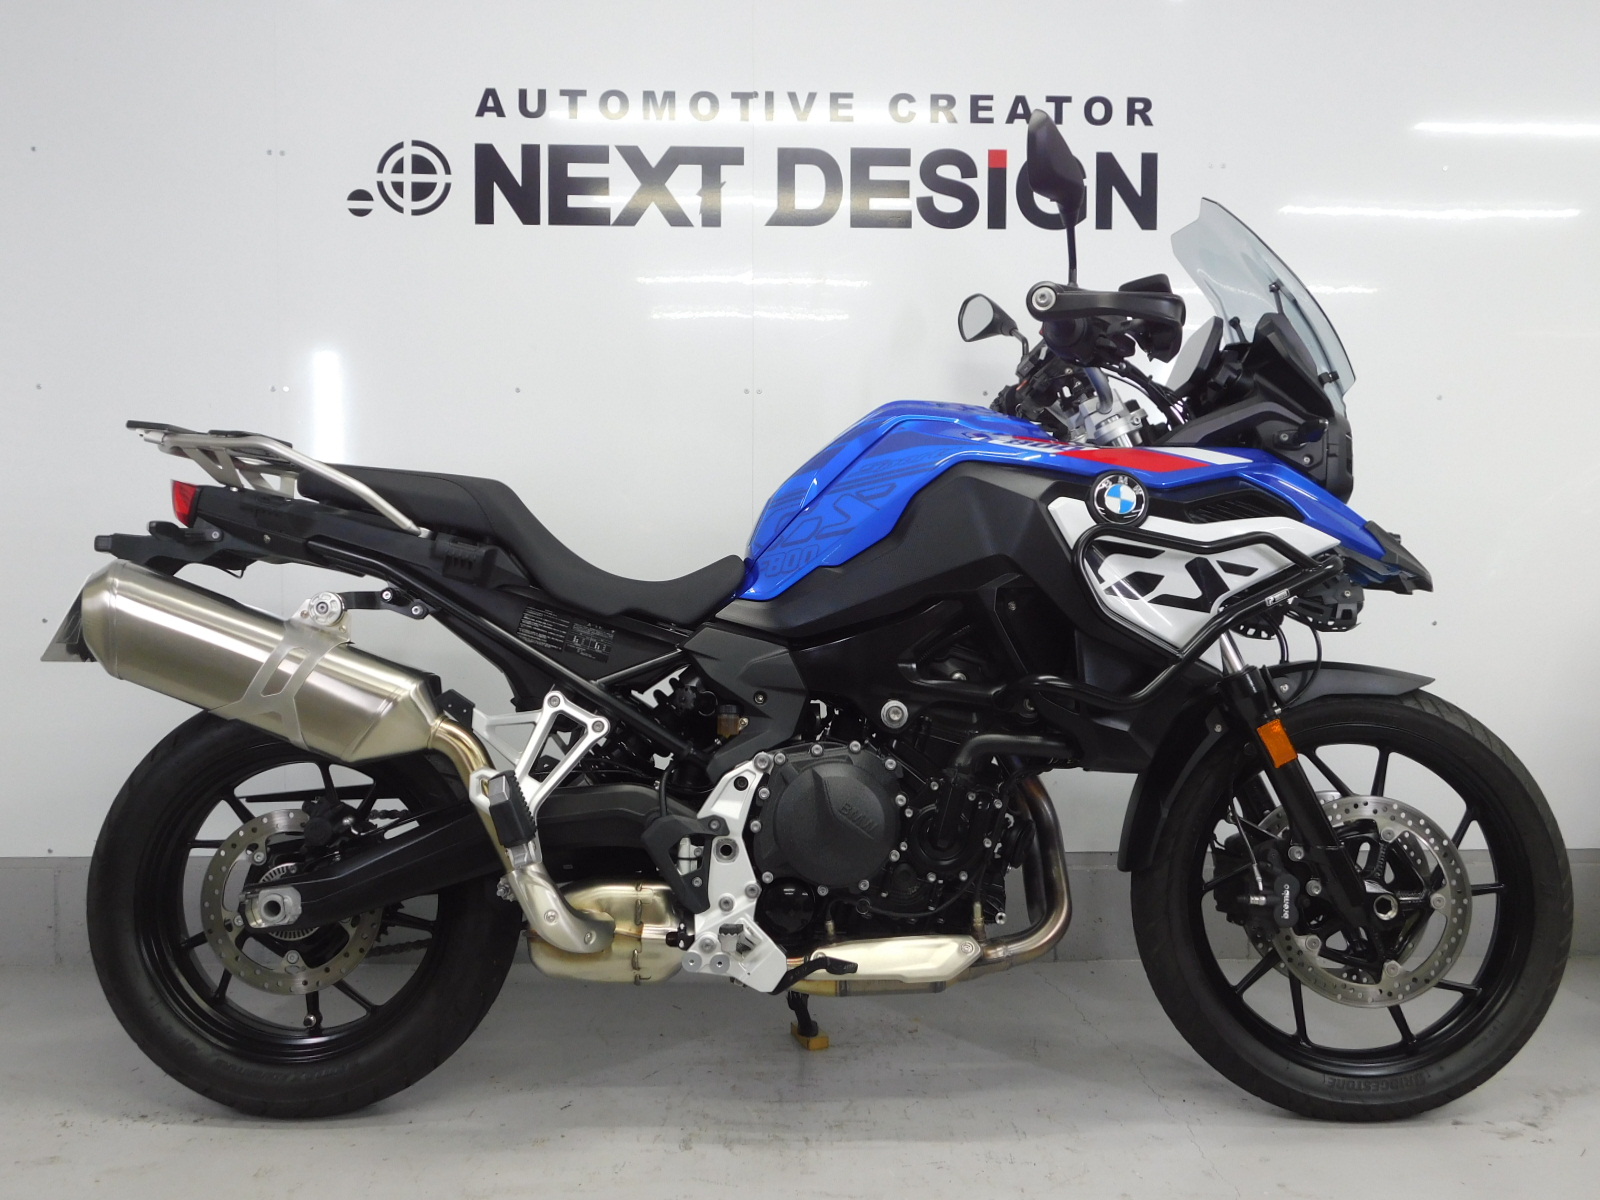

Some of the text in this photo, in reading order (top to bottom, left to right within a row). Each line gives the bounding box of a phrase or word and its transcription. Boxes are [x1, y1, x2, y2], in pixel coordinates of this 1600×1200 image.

[475, 87, 1154, 126] AUTOMOTIVE CREATOR
[474, 143, 745, 228] NEXT
[1099, 475, 1143, 495] BMW
[840, 802, 879, 833] BMW
[1281, 884, 1290, 919] brembo
